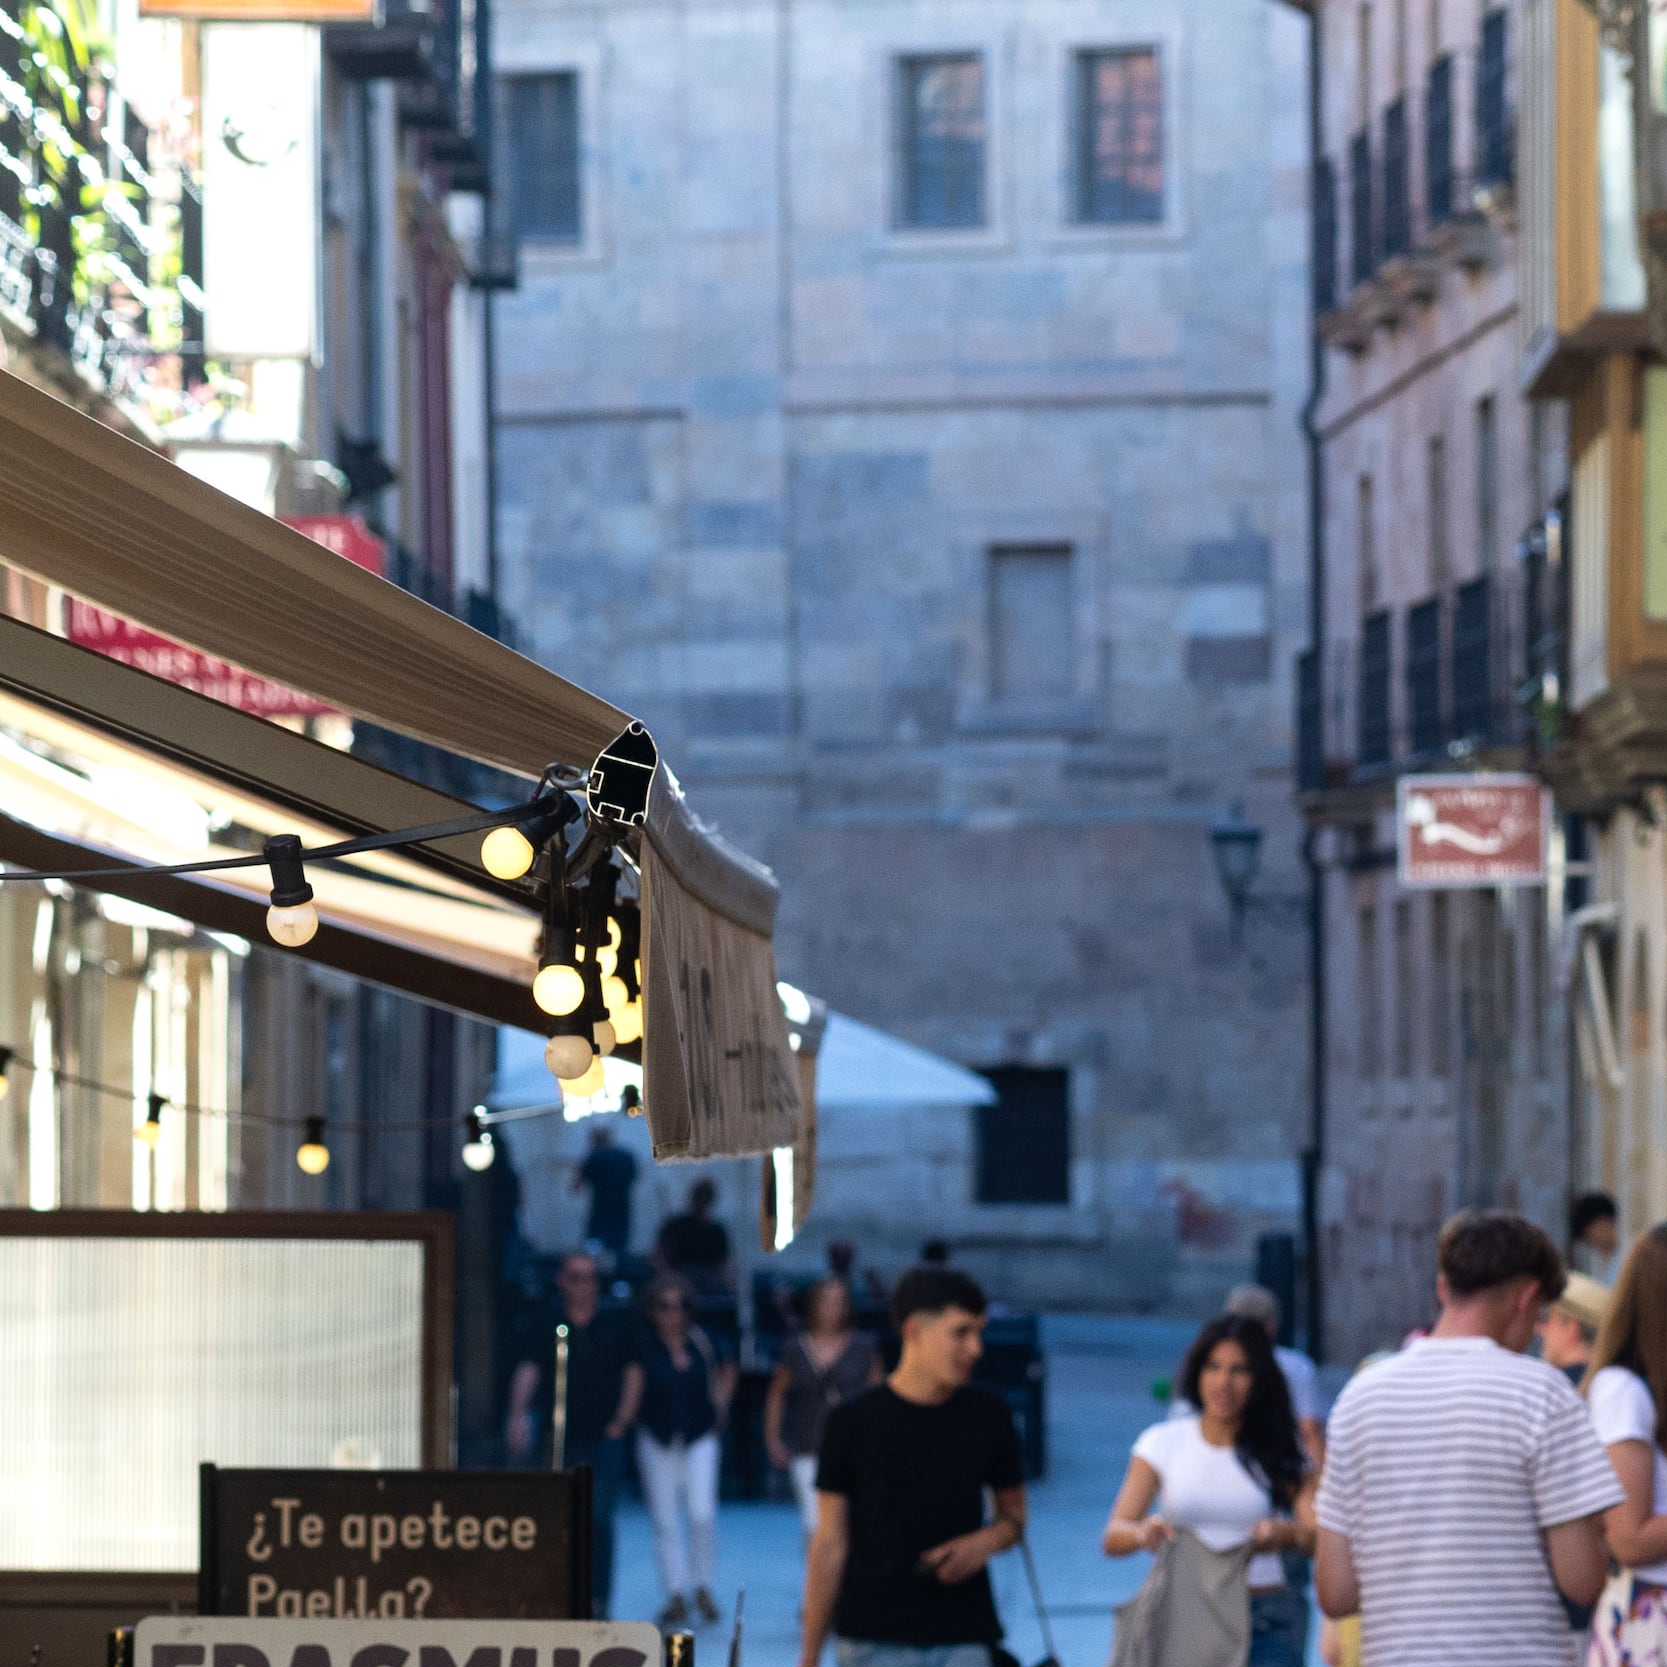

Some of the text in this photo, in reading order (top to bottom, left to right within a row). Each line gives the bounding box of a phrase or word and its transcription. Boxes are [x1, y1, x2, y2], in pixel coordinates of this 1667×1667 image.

[246, 1499, 538, 1562] ¿Te apetece
[247, 1574, 433, 1620] Paella?
